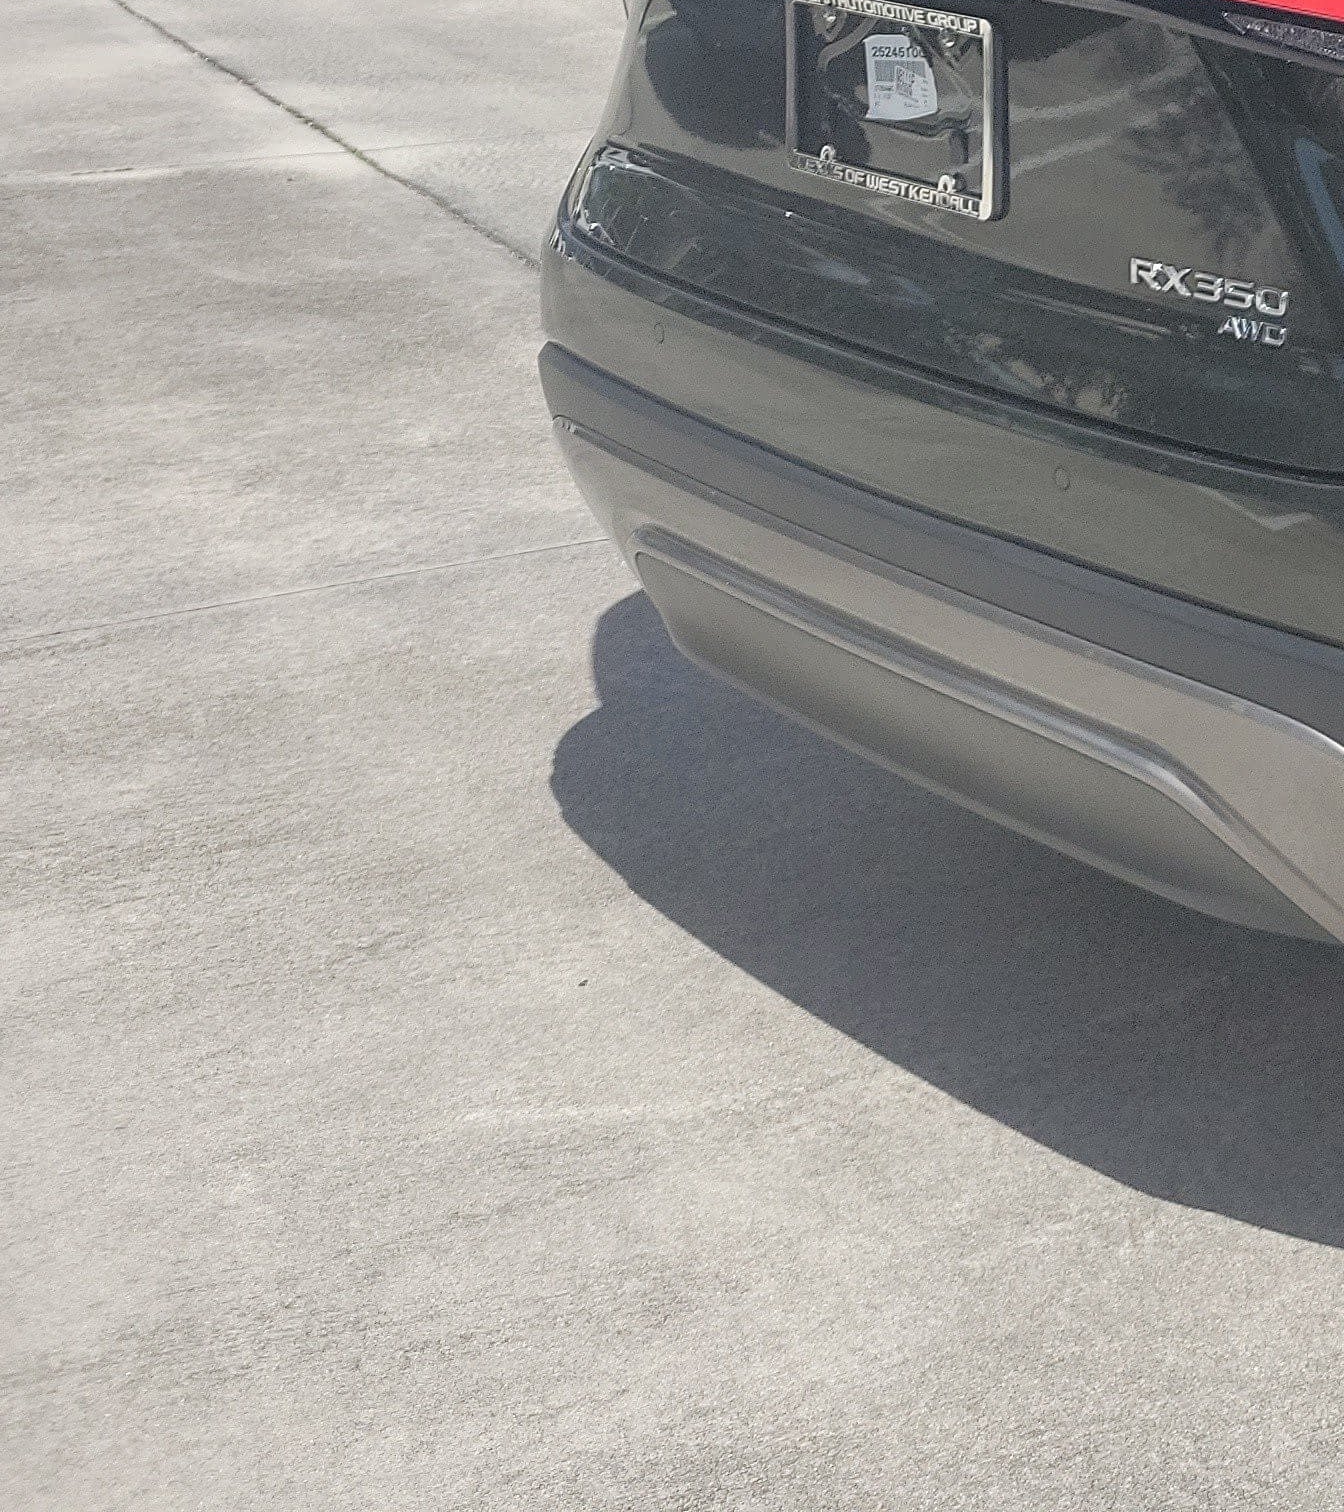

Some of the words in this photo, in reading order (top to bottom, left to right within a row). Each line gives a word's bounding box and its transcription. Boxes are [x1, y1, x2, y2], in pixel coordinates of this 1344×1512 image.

[926, 11, 978, 32] GROUP
[845, 169, 865, 185] OF
[866, 174, 910, 197] WEST
[909, 184, 980, 216] KENDALL
[1130, 257, 1289, 317] RX350
[1217, 315, 1287, 346] AWD
